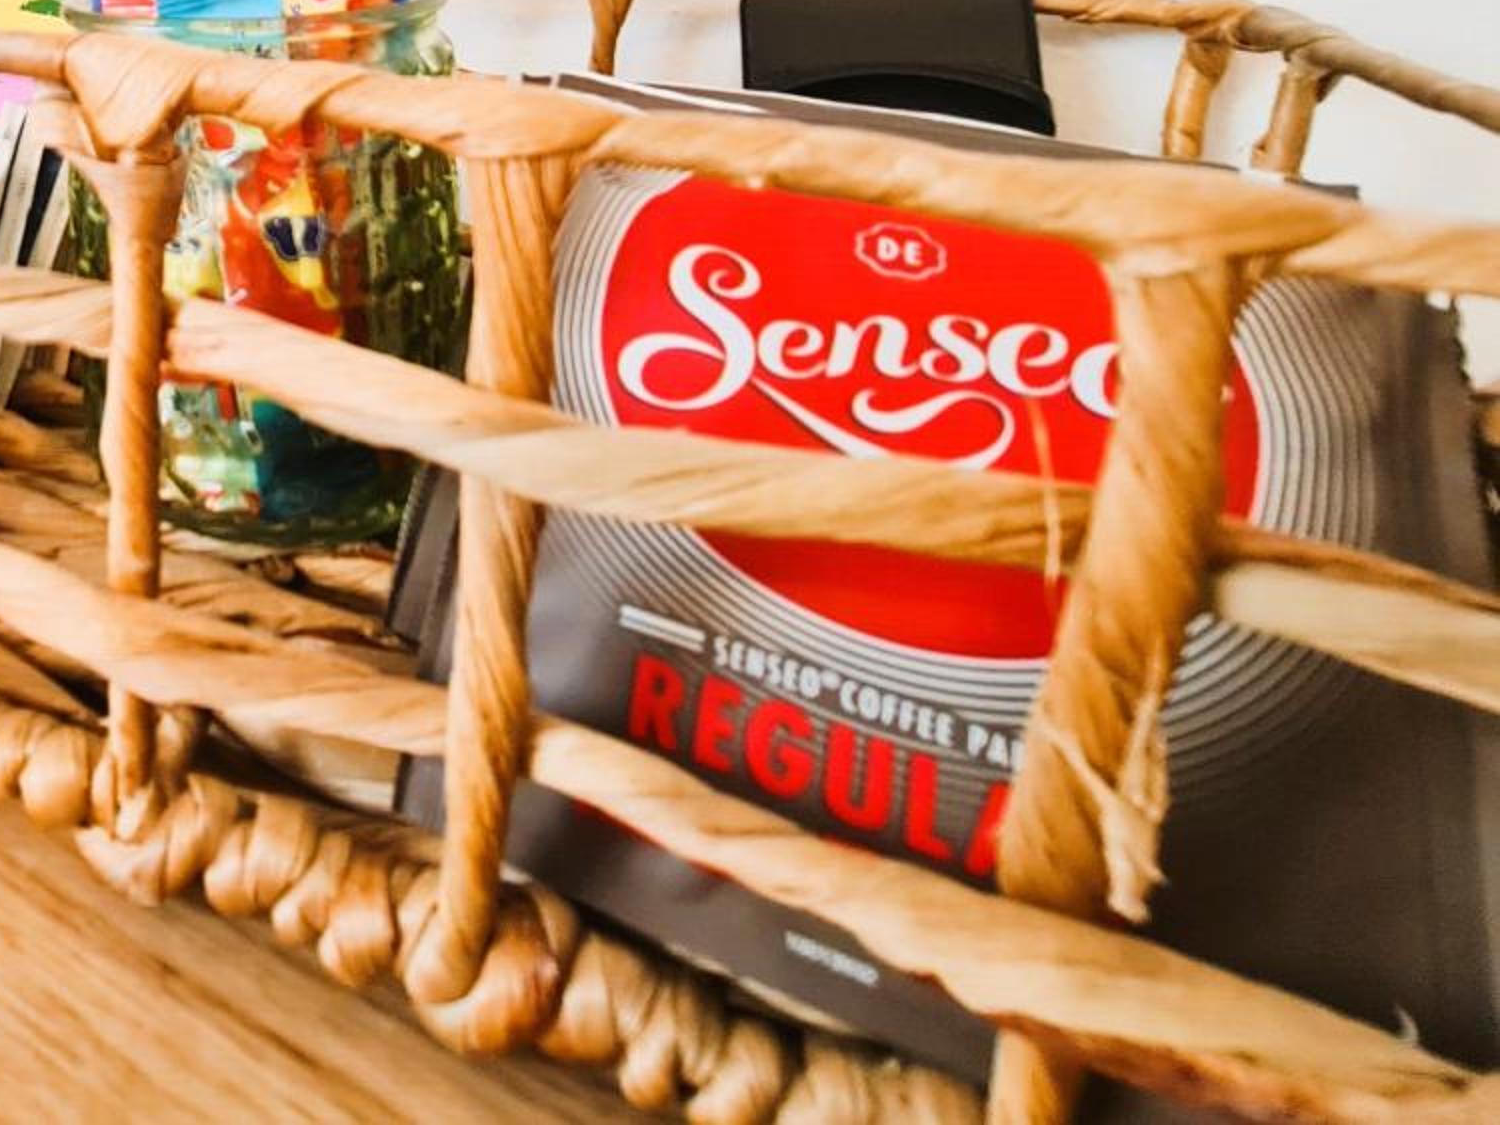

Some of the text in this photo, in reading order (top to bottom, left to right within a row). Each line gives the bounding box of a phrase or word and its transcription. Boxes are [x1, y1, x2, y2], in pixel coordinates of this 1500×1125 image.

[628, 651, 1014, 875] REGUL
[839, 678, 953, 747] COFFEE
[967, 723, 1026, 773] PA
